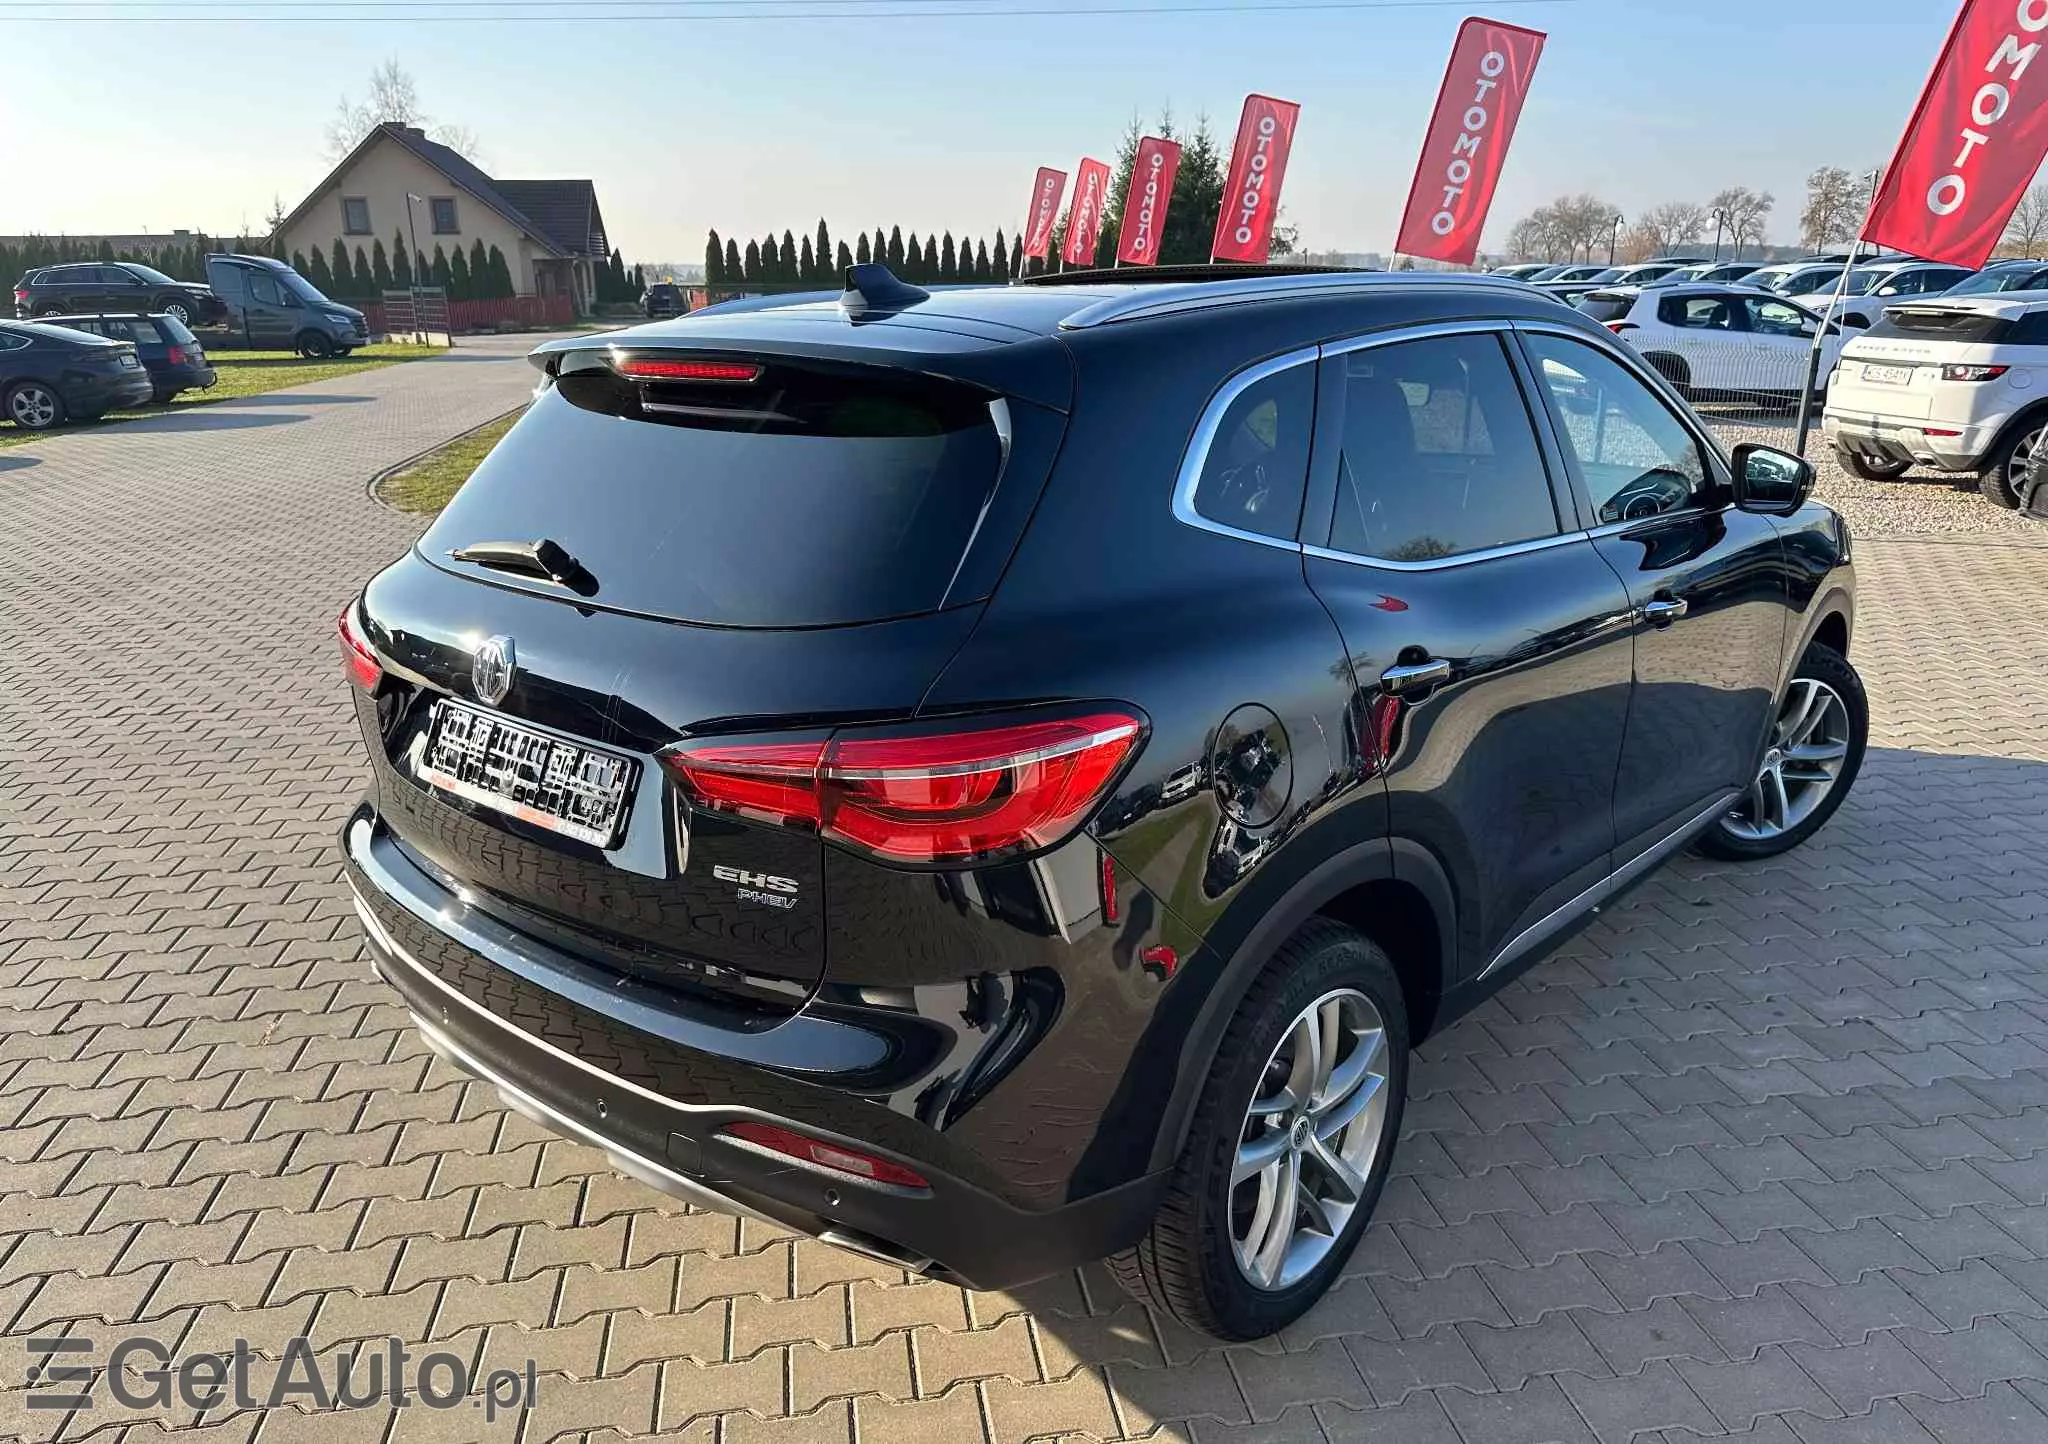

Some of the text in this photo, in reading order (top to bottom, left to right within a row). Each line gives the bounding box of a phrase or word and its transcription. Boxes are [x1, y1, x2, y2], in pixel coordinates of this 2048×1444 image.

[1235, 116, 1276, 244] OTOMOTO
[1431, 51, 1505, 236] OTOMOTO
[1034, 178, 1055, 246] OTOMO
[1134, 153, 1164, 251] OTOMOTO
[713, 864, 800, 893] EHS
[737, 888, 800, 909] PHEV
